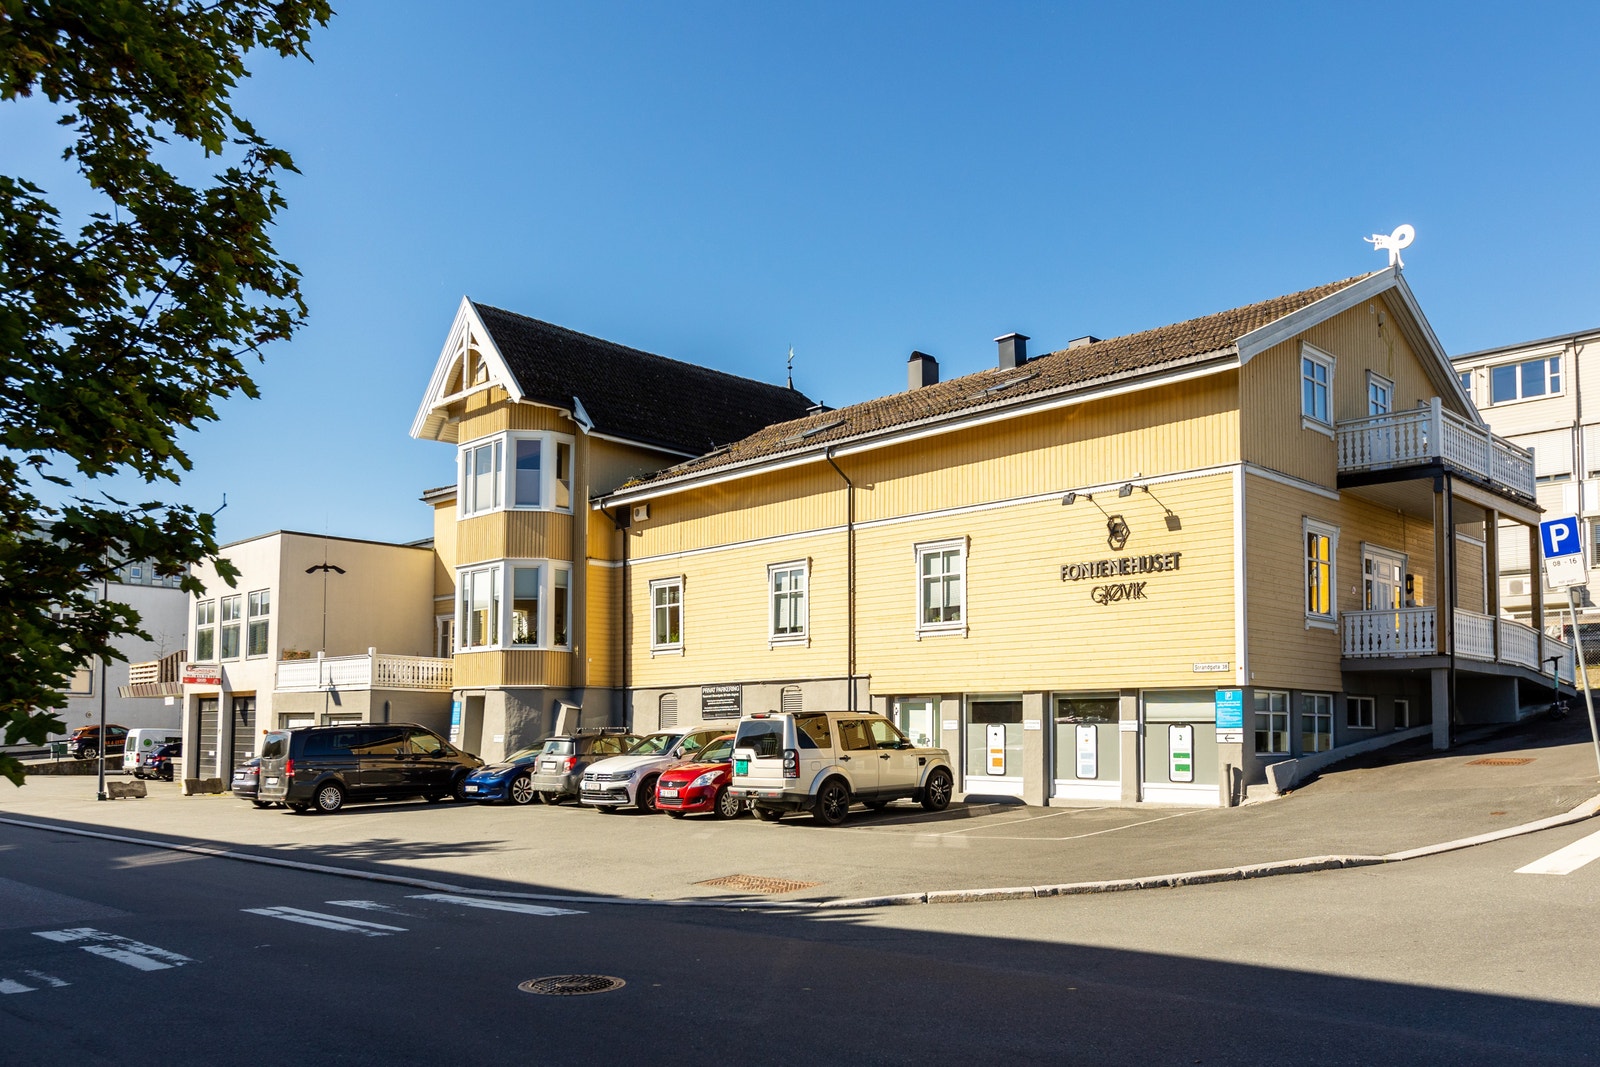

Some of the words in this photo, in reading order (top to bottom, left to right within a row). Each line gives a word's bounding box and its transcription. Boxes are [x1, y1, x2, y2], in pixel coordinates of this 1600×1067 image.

[1549, 523, 1570, 553] P
[1060, 552, 1182, 582] FONTENEHUSET
[1091, 581, 1148, 606] GJØVIK
